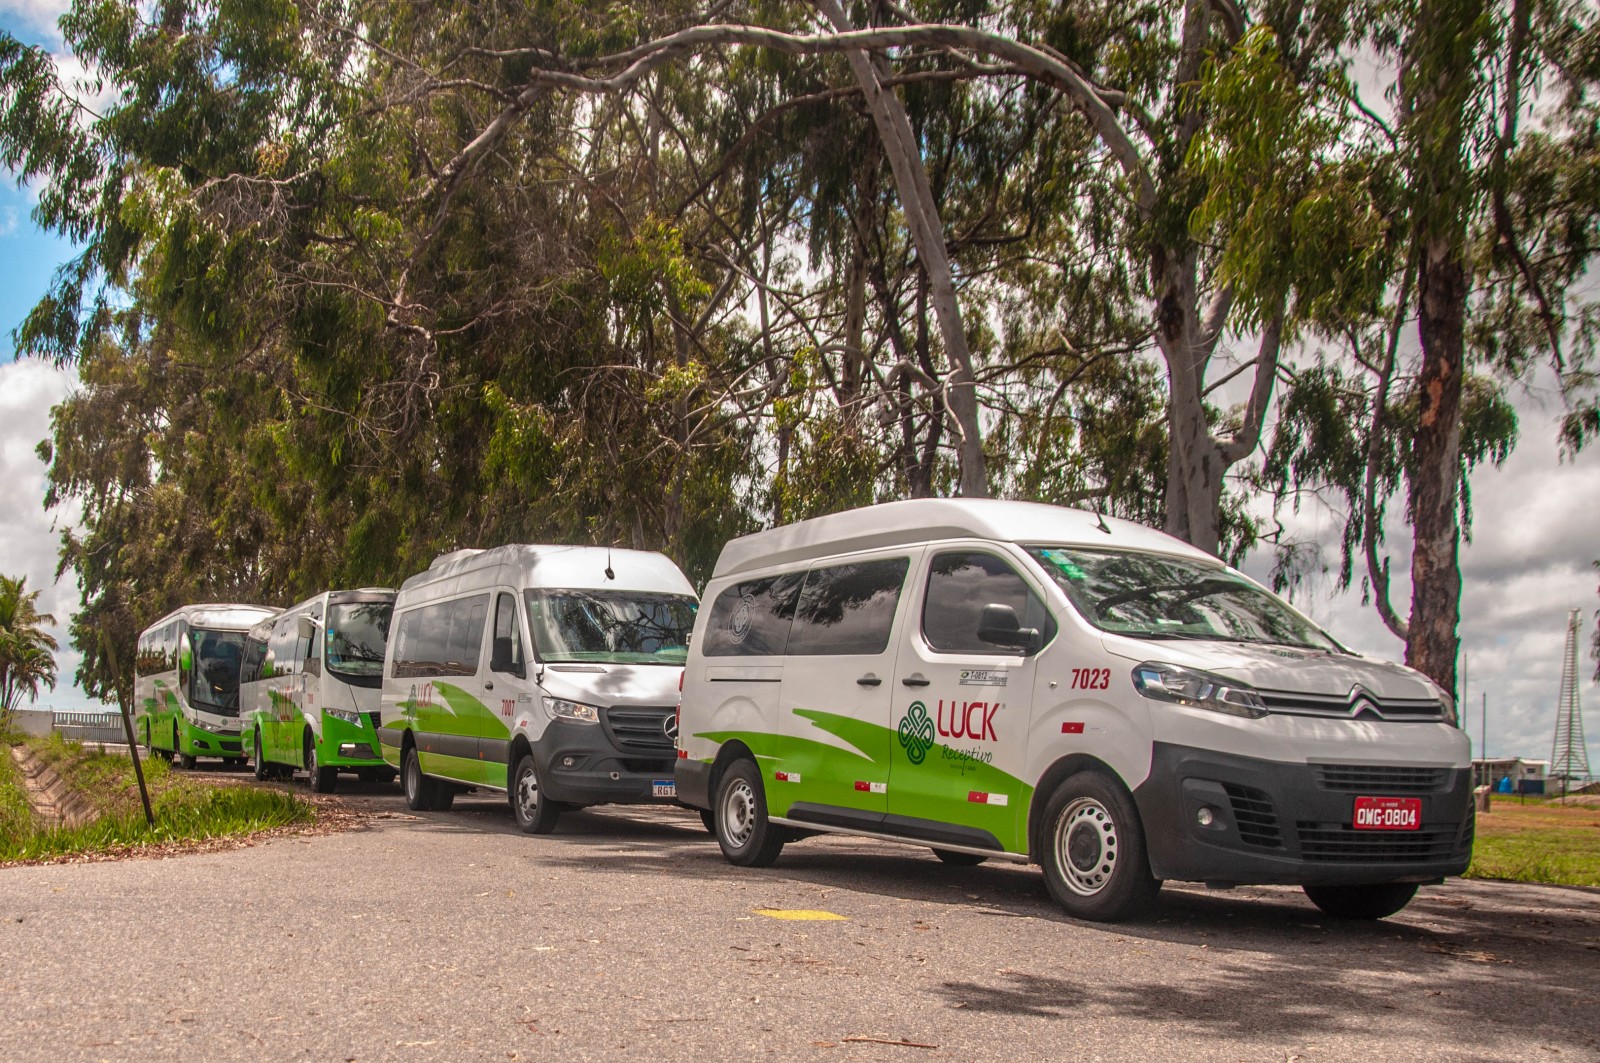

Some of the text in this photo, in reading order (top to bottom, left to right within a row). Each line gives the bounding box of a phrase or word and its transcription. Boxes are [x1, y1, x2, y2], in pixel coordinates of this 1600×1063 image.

[1071, 668, 1111, 690] 7023
[937, 699, 1001, 742] LUCK
[942, 743, 993, 776] Receptivo
[657, 786, 677, 795] RGT
